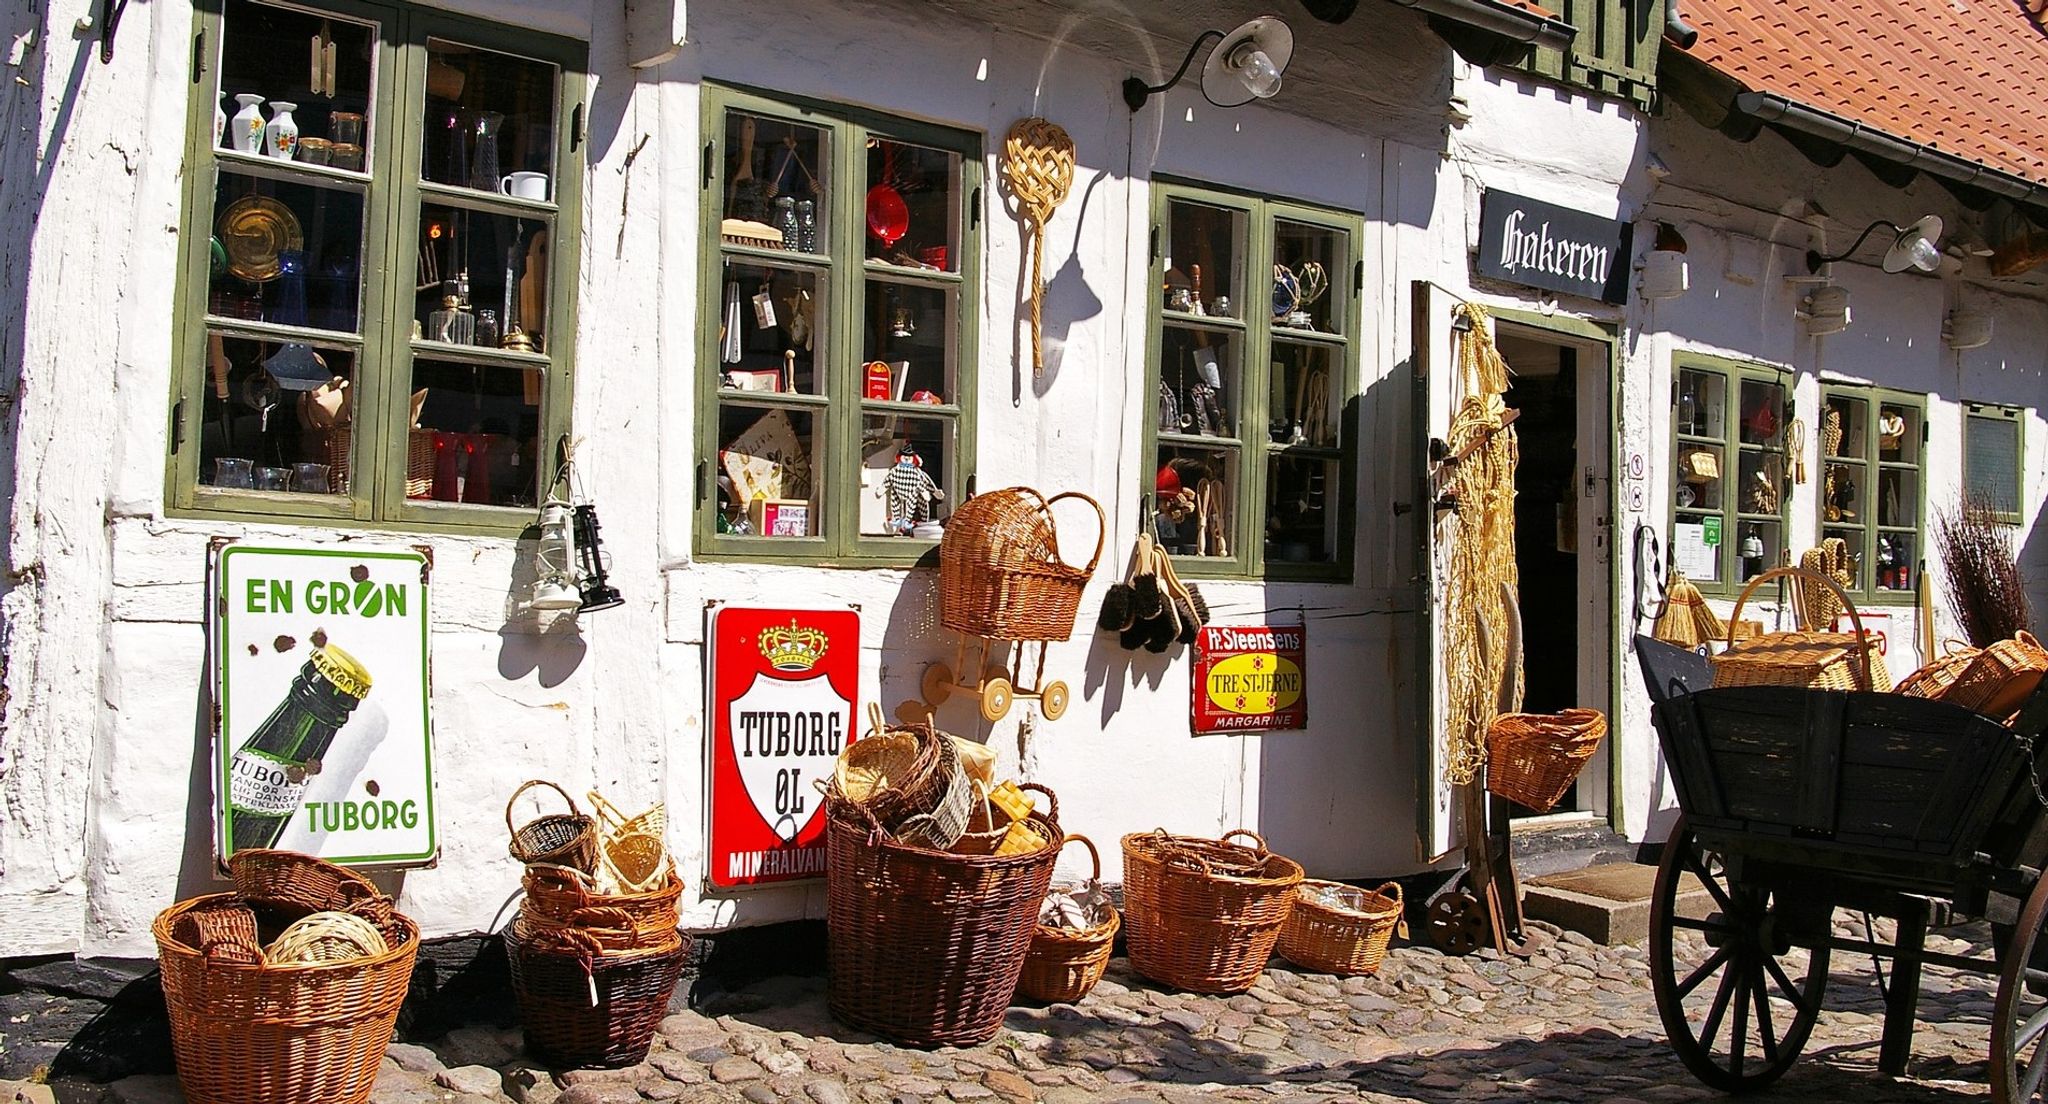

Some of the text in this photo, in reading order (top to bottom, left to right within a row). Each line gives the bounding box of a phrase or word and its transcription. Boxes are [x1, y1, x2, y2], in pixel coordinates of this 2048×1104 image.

[1500, 209, 1608, 285] Høkeren
[246, 578, 407, 618] EN GRØN
[1212, 672, 1299, 693] TRE STJERNE
[739, 711, 842, 757] TUBORG
[1214, 715, 1292, 728] MARGARINE
[775, 768, 804, 815] ØL
[304, 799, 418, 833] TUBORG
[728, 847, 829, 879] MINERALVAN
